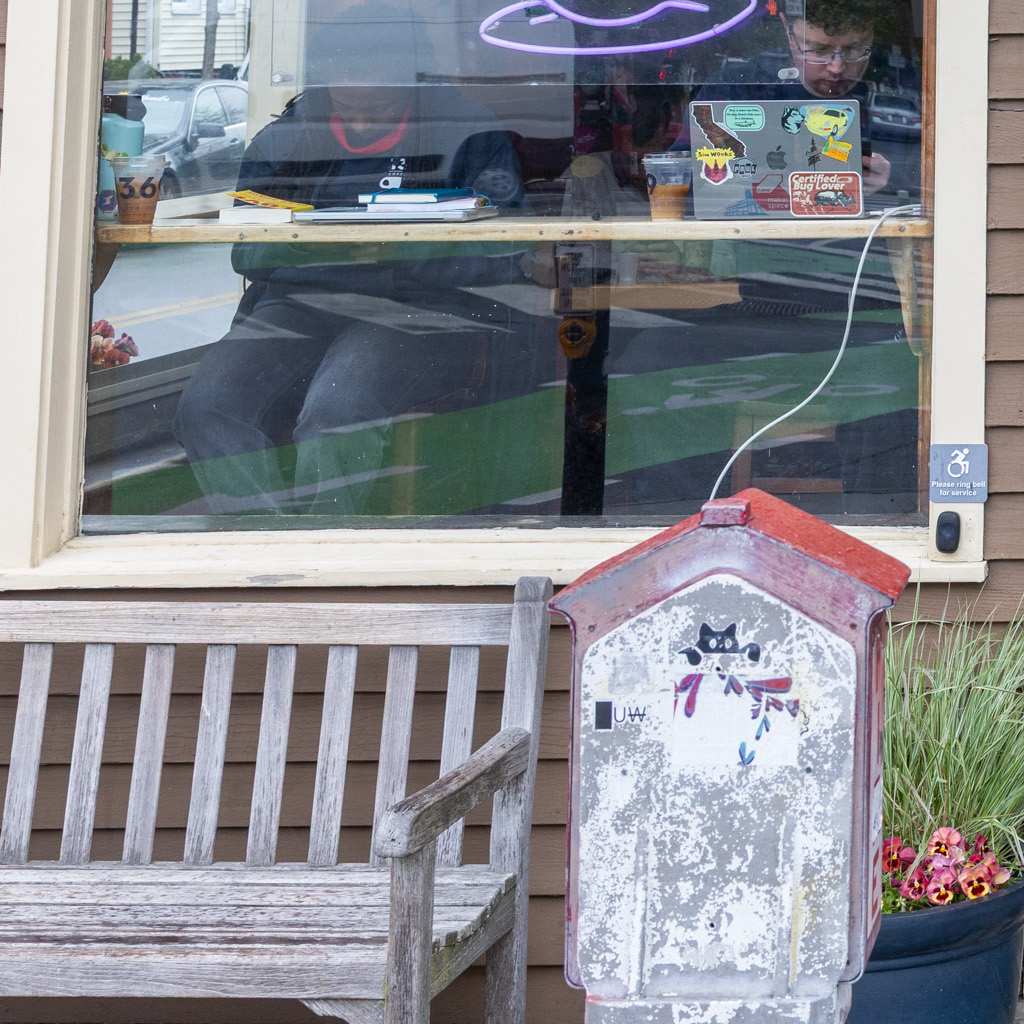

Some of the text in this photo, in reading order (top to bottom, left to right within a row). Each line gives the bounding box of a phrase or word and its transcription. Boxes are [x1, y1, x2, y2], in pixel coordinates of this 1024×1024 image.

[792, 174, 837, 183] Certified
[793, 182, 845, 192] Bug Lover
[956, 481, 971, 489] ring
